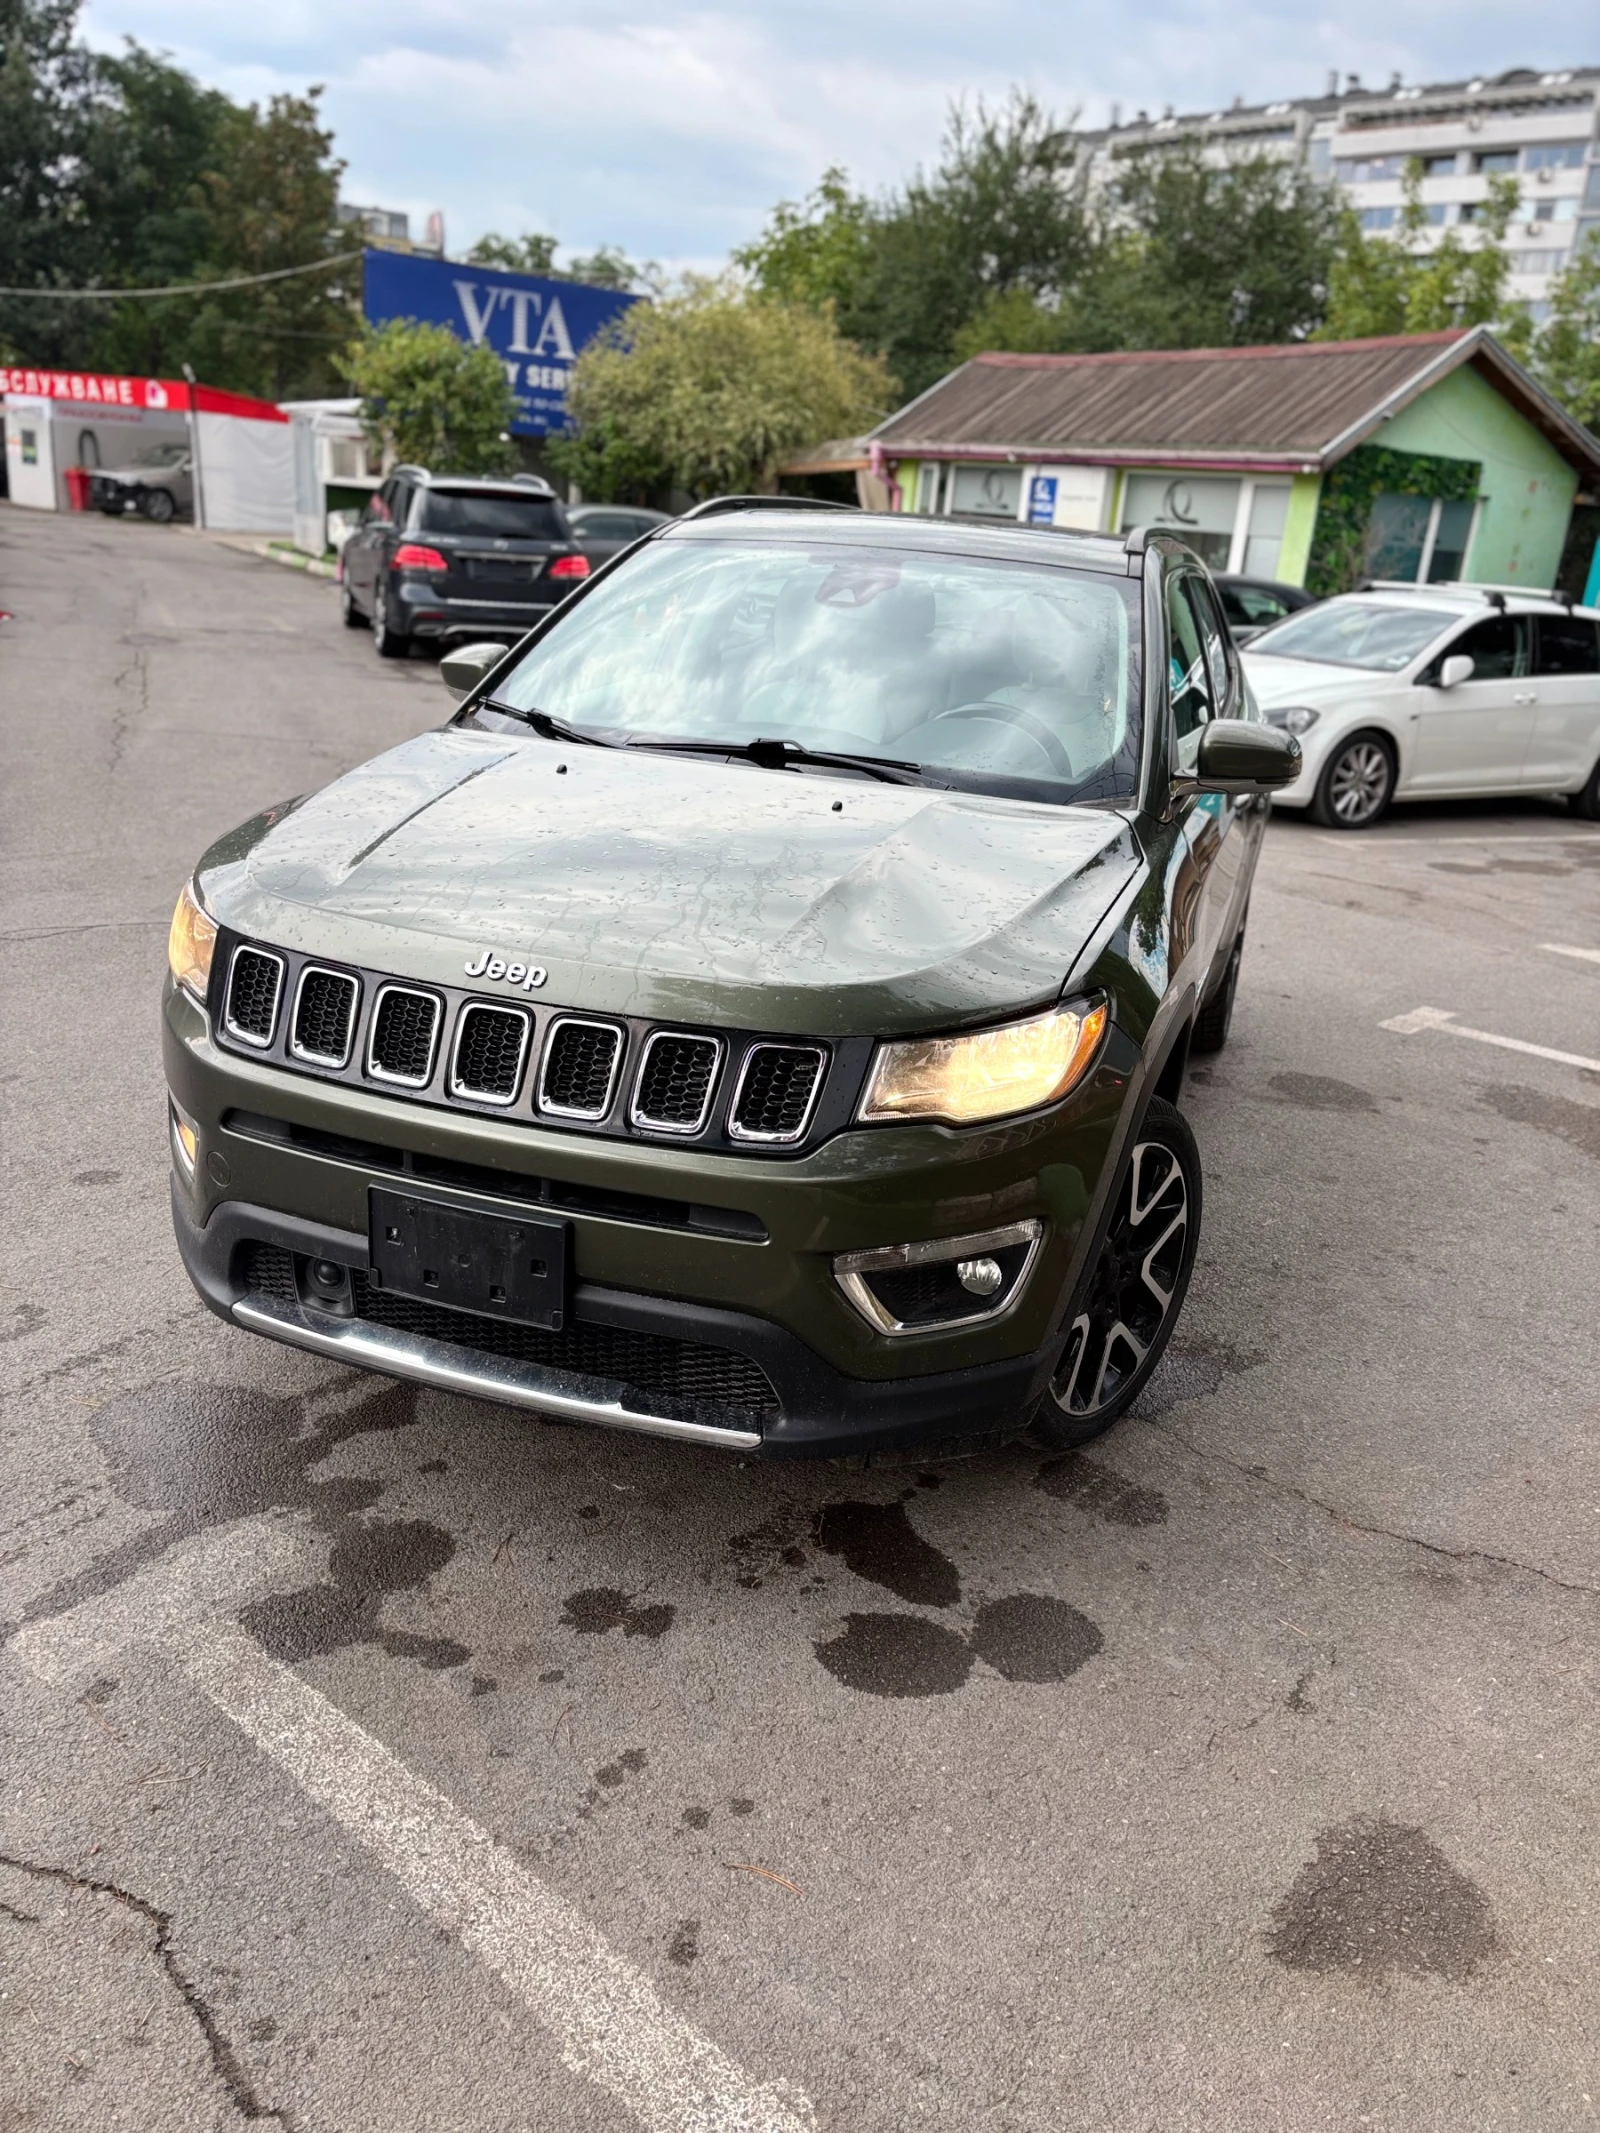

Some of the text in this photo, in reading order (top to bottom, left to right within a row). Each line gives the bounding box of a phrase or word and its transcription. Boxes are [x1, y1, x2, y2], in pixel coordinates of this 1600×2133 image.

[452, 279, 577, 360] VTA
[505, 362, 521, 385] Y
[464, 951, 548, 992] Jeep
